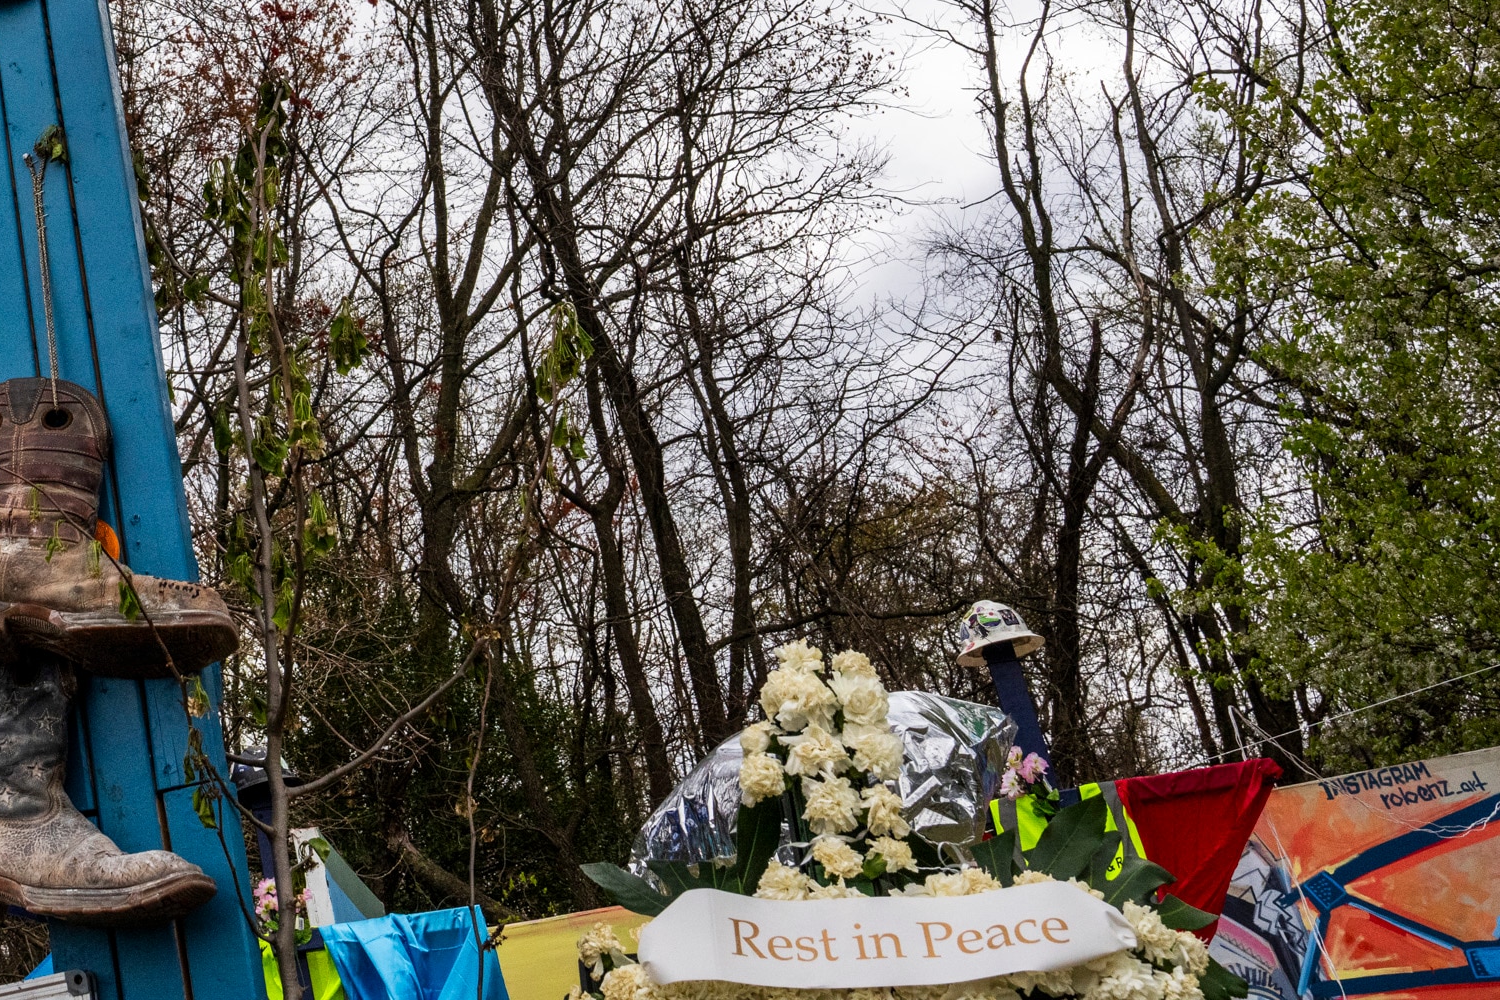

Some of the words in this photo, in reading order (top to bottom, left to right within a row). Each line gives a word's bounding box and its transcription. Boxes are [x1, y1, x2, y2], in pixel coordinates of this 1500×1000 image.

[1318, 761, 1432, 801] INSTAGRAM
[727, 916, 840, 962] Rest
[851, 922, 908, 961] in
[915, 916, 1072, 959] Peace
